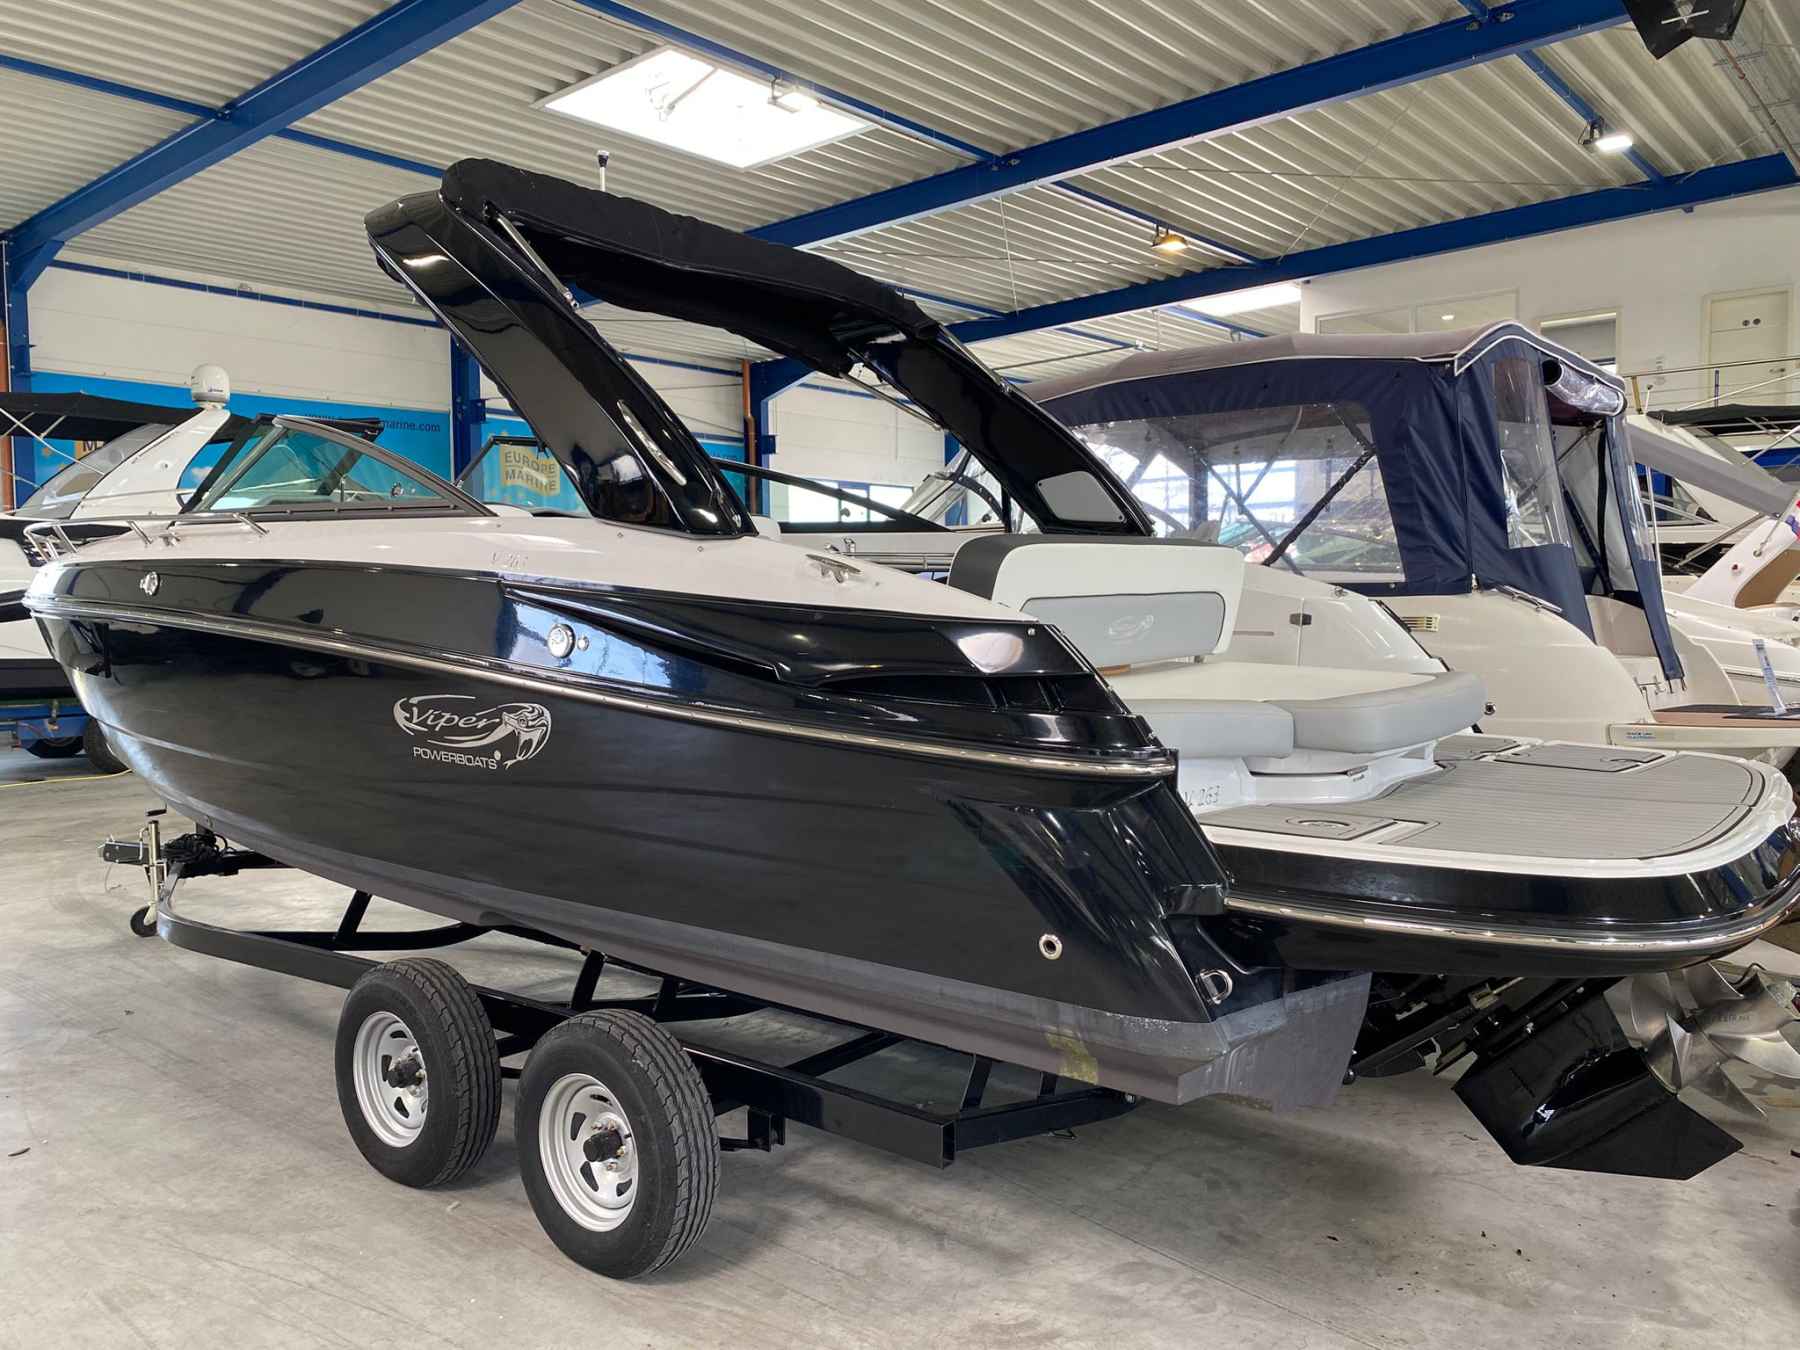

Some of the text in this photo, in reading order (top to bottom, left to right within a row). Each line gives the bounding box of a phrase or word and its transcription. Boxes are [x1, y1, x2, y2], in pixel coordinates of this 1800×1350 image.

[383, 418, 441, 433] marine.com
[504, 450, 556, 474] EUROPE
[504, 469, 557, 491] MARINE
[412, 706, 500, 731] Viper
[413, 746, 498, 770] POWERBOATS
